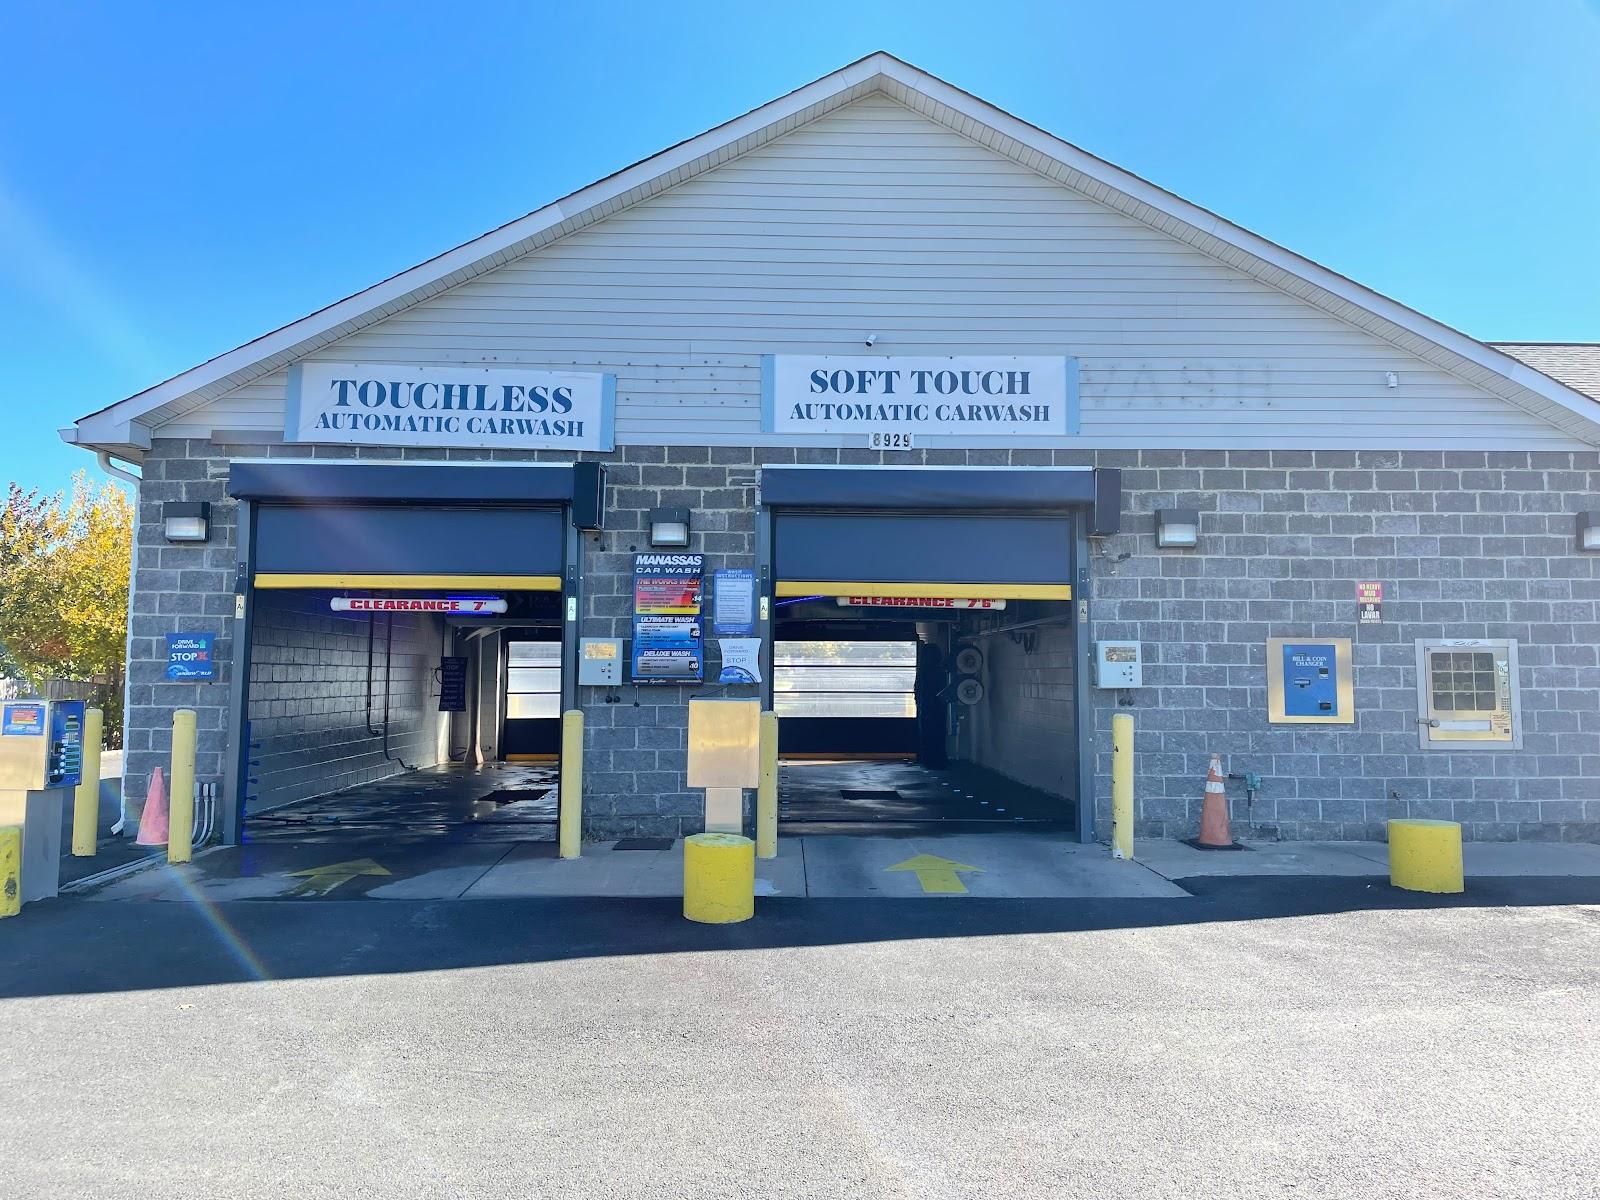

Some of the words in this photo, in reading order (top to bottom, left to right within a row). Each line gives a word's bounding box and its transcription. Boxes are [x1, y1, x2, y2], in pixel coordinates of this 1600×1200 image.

[810, 369, 901, 395] SOFT
[910, 369, 1031, 395] TOUCH
[330, 379, 574, 414] TOUCHLESS
[790, 402, 929, 421] AUTOMATIC
[935, 403, 1050, 422] CARWASH
[314, 411, 460, 433] AUTOMATIC
[466, 416, 584, 438] CARWASH
[873, 432, 910, 447] 8929
[636, 555, 702, 565] MANASSAS
[350, 599, 459, 610] CLEARANCE
[473, 601, 486, 610] 7'
[849, 596, 954, 607] CLEARANCE
[1361, 610, 1379, 618] LAVAR
[171, 652, 197, 661] STOP
